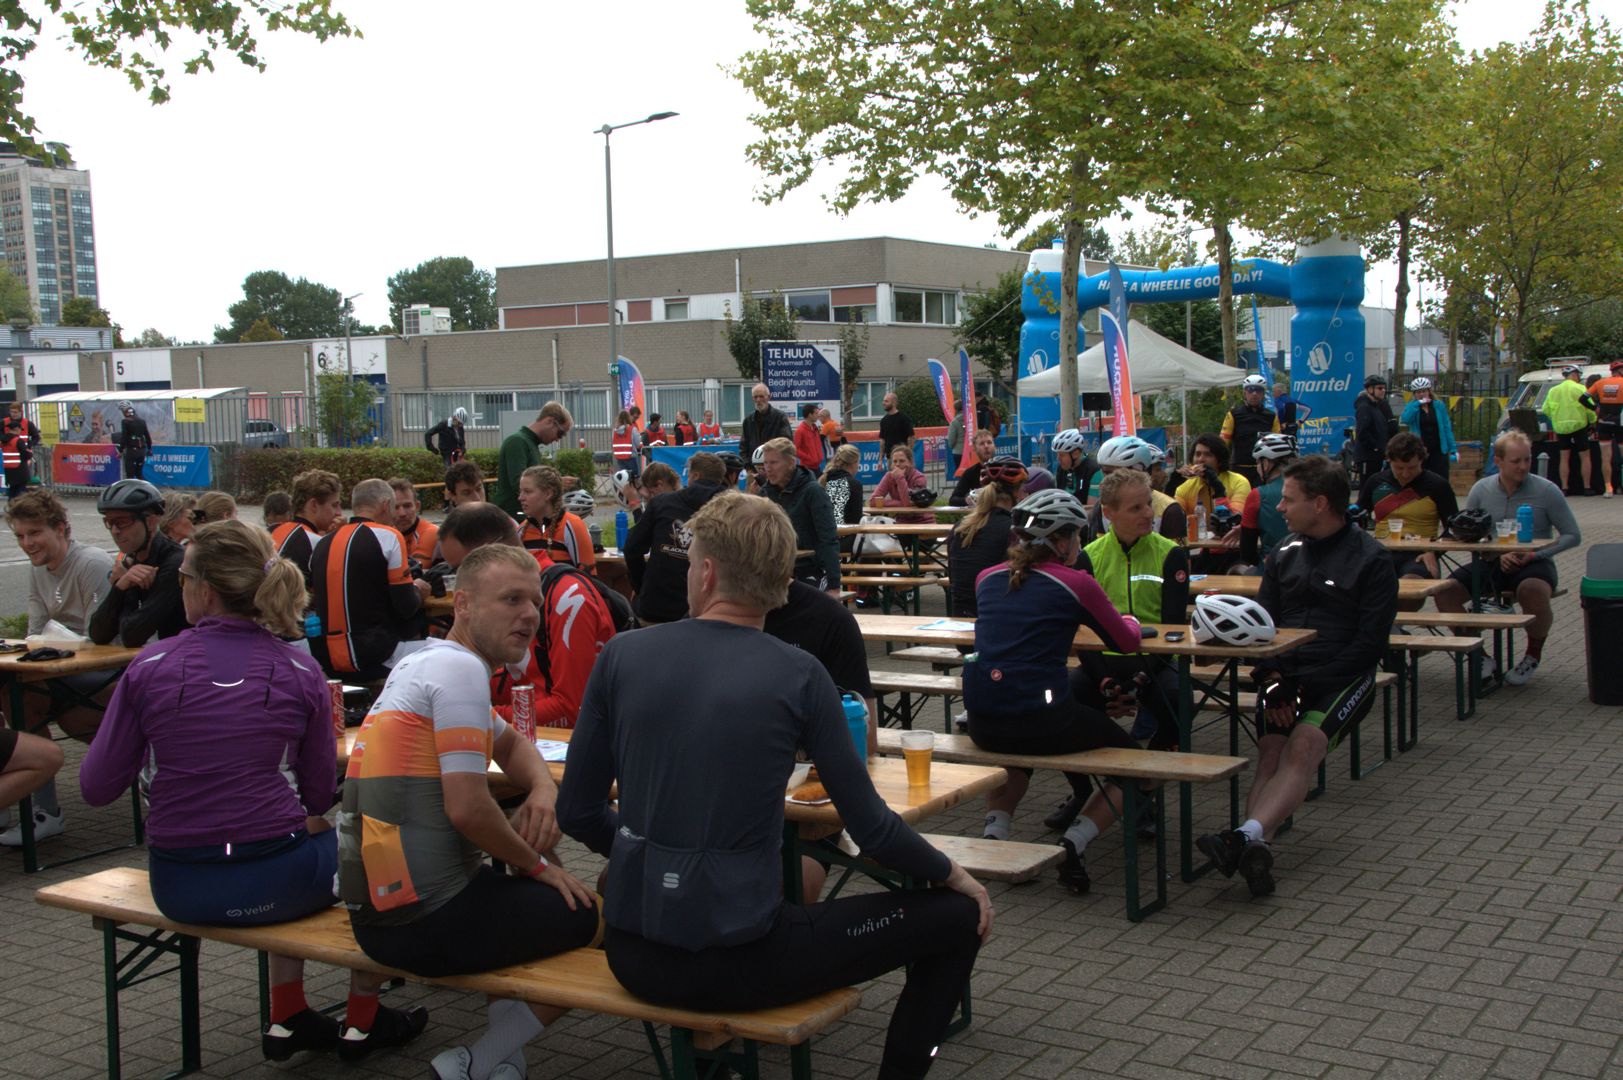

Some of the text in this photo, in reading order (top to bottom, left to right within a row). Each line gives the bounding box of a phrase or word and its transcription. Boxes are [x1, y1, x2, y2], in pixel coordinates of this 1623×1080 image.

[1098, 270, 1263, 292] HE A WHEELIE GOO DAY!
[318, 352, 326, 368] 6
[768, 348, 781, 358] TE
[783, 348, 814, 358] HUUR
[28, 364, 35, 378] 4
[117, 361, 124, 376] 5
[768, 378, 816, 388] Bedrijfsunits
[1294, 374, 1351, 392] mantel
[70, 454, 111, 464] NIBC TOUR
[162, 454, 167, 462] A
[168, 454, 195, 463] WHEELIE
[154, 464, 187, 473] GOOD DAY
[244, 902, 276, 916] Velor
